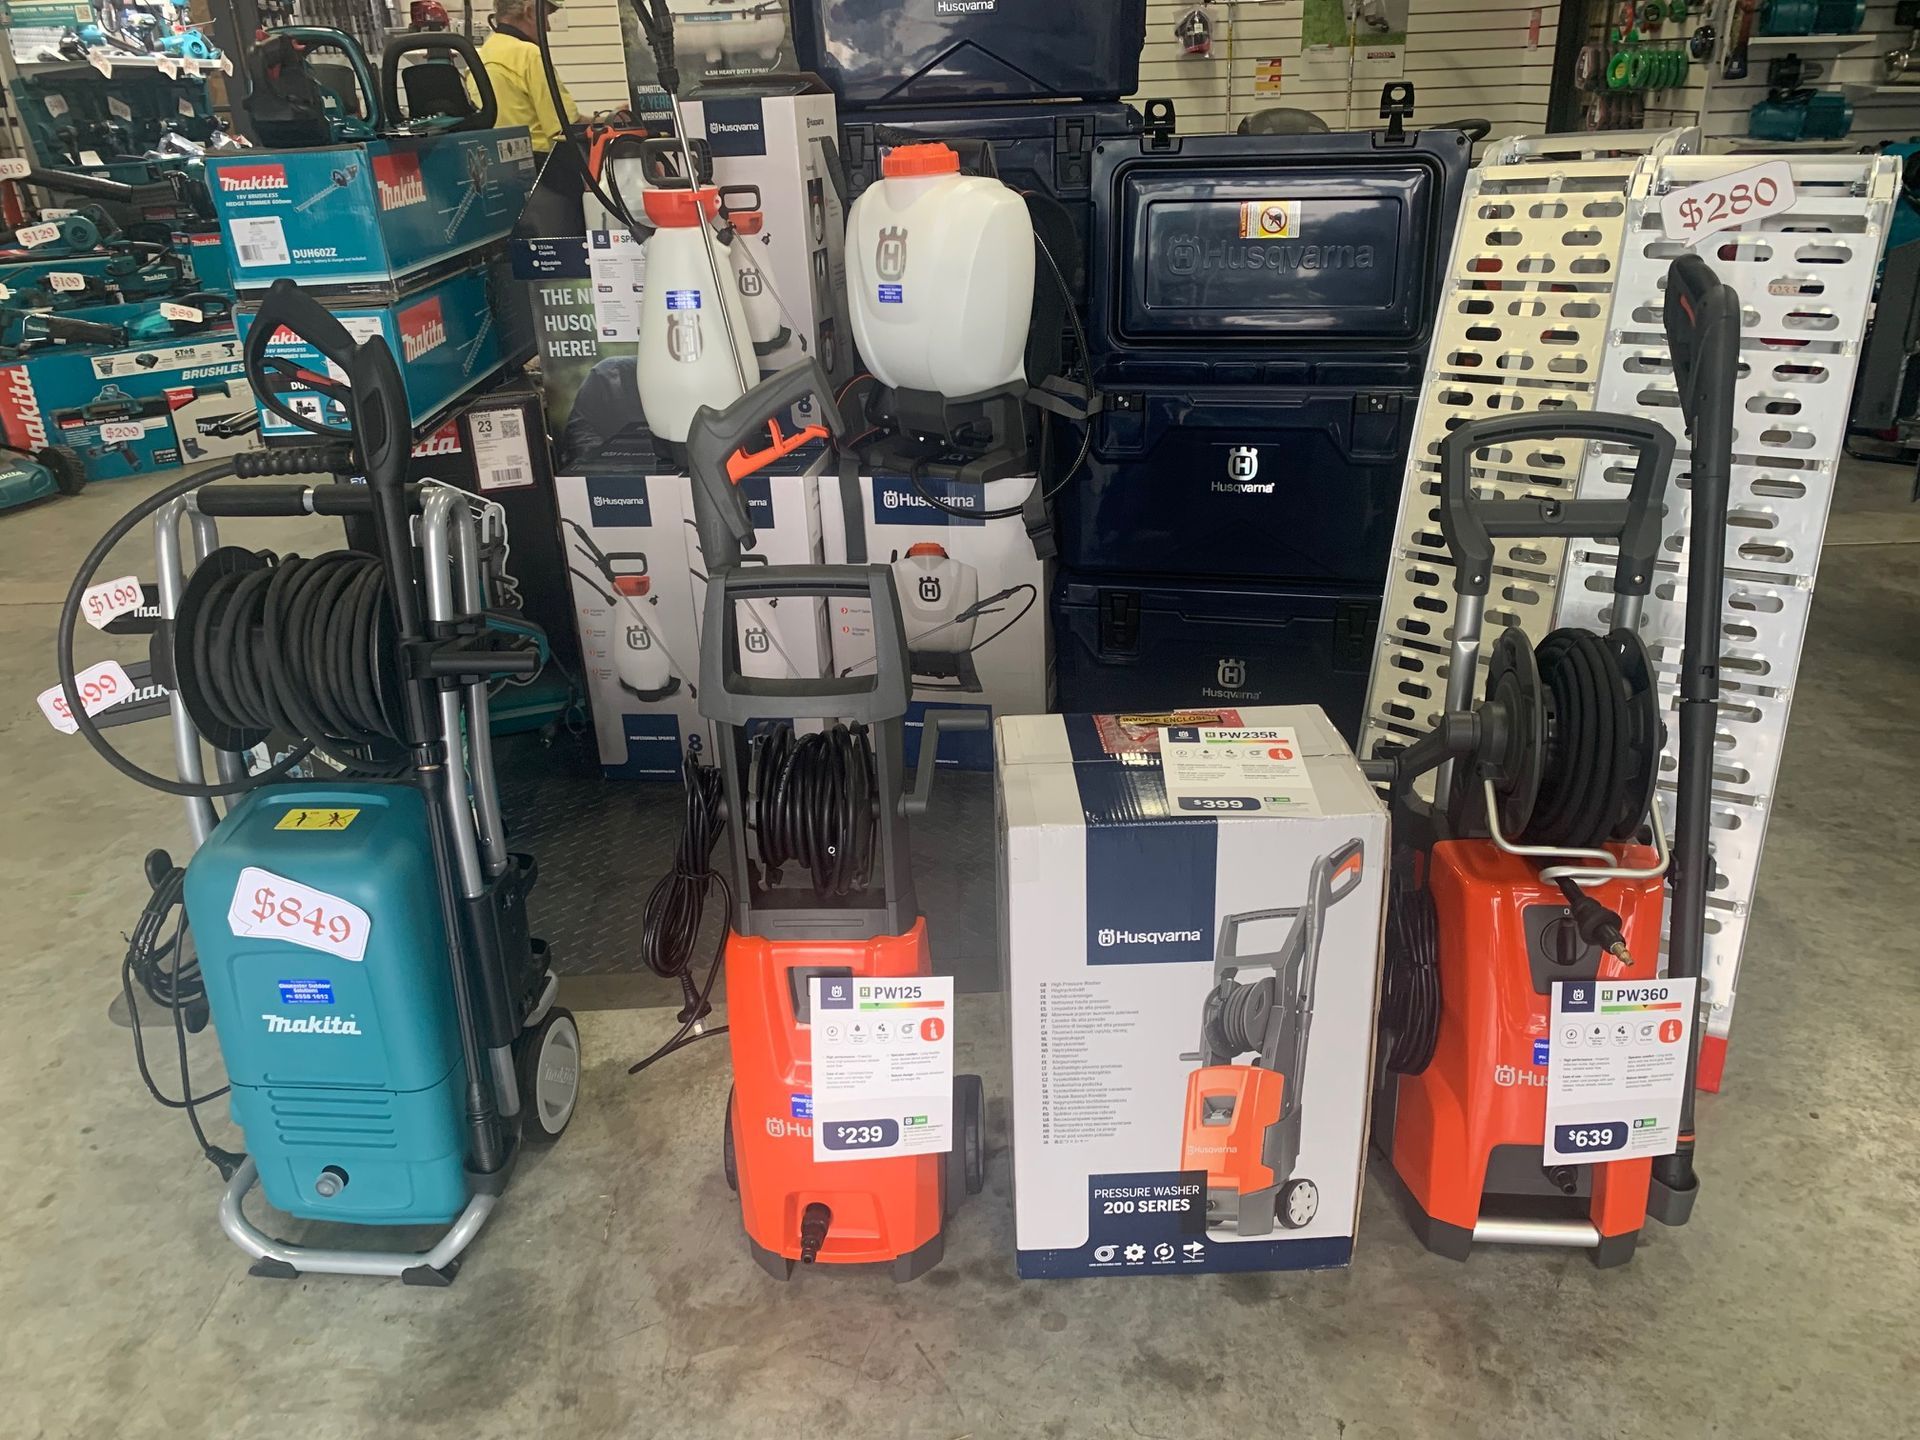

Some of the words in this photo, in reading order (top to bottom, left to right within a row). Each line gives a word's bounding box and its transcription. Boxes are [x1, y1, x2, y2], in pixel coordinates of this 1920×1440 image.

[938, 1, 994, 12] Husqvarna
[718, 122, 760, 133] Husqvarna
[248, 192, 278, 200] BRUSHLESS
[1680, 178, 1778, 230] $280
[22, 228, 55, 242] $129
[292, 248, 338, 258] DUH602Z
[1203, 239, 1374, 274] Husqvarna
[540, 288, 574, 306] THE
[548, 340, 597, 358] HERE!
[105, 428, 139, 438] $209
[478, 420, 493, 433] 23
[1212, 482, 1275, 494] Husqvarna
[602, 496, 644, 506] Husqvarna
[899, 494, 975, 508] Husvarna
[88, 585, 138, 616] $199
[1202, 687, 1261, 700] Husqvarna
[1219, 731, 1278, 739] PW235R
[688, 734, 703, 752] 8
[1193, 800, 1244, 809] $399
[252, 887, 352, 945] $849
[1116, 930, 1201, 946] Husqvarna
[874, 986, 922, 1000] PW125
[1616, 988, 1668, 1002] PW360
[838, 1126, 882, 1144] $239
[1568, 1128, 1613, 1148] $639
[1094, 1187, 1150, 1199] PRESSURE
[1154, 1185, 1200, 1196] WASHER
[1104, 1201, 1134, 1214] 200
[1138, 1199, 1190, 1213] SERIES
